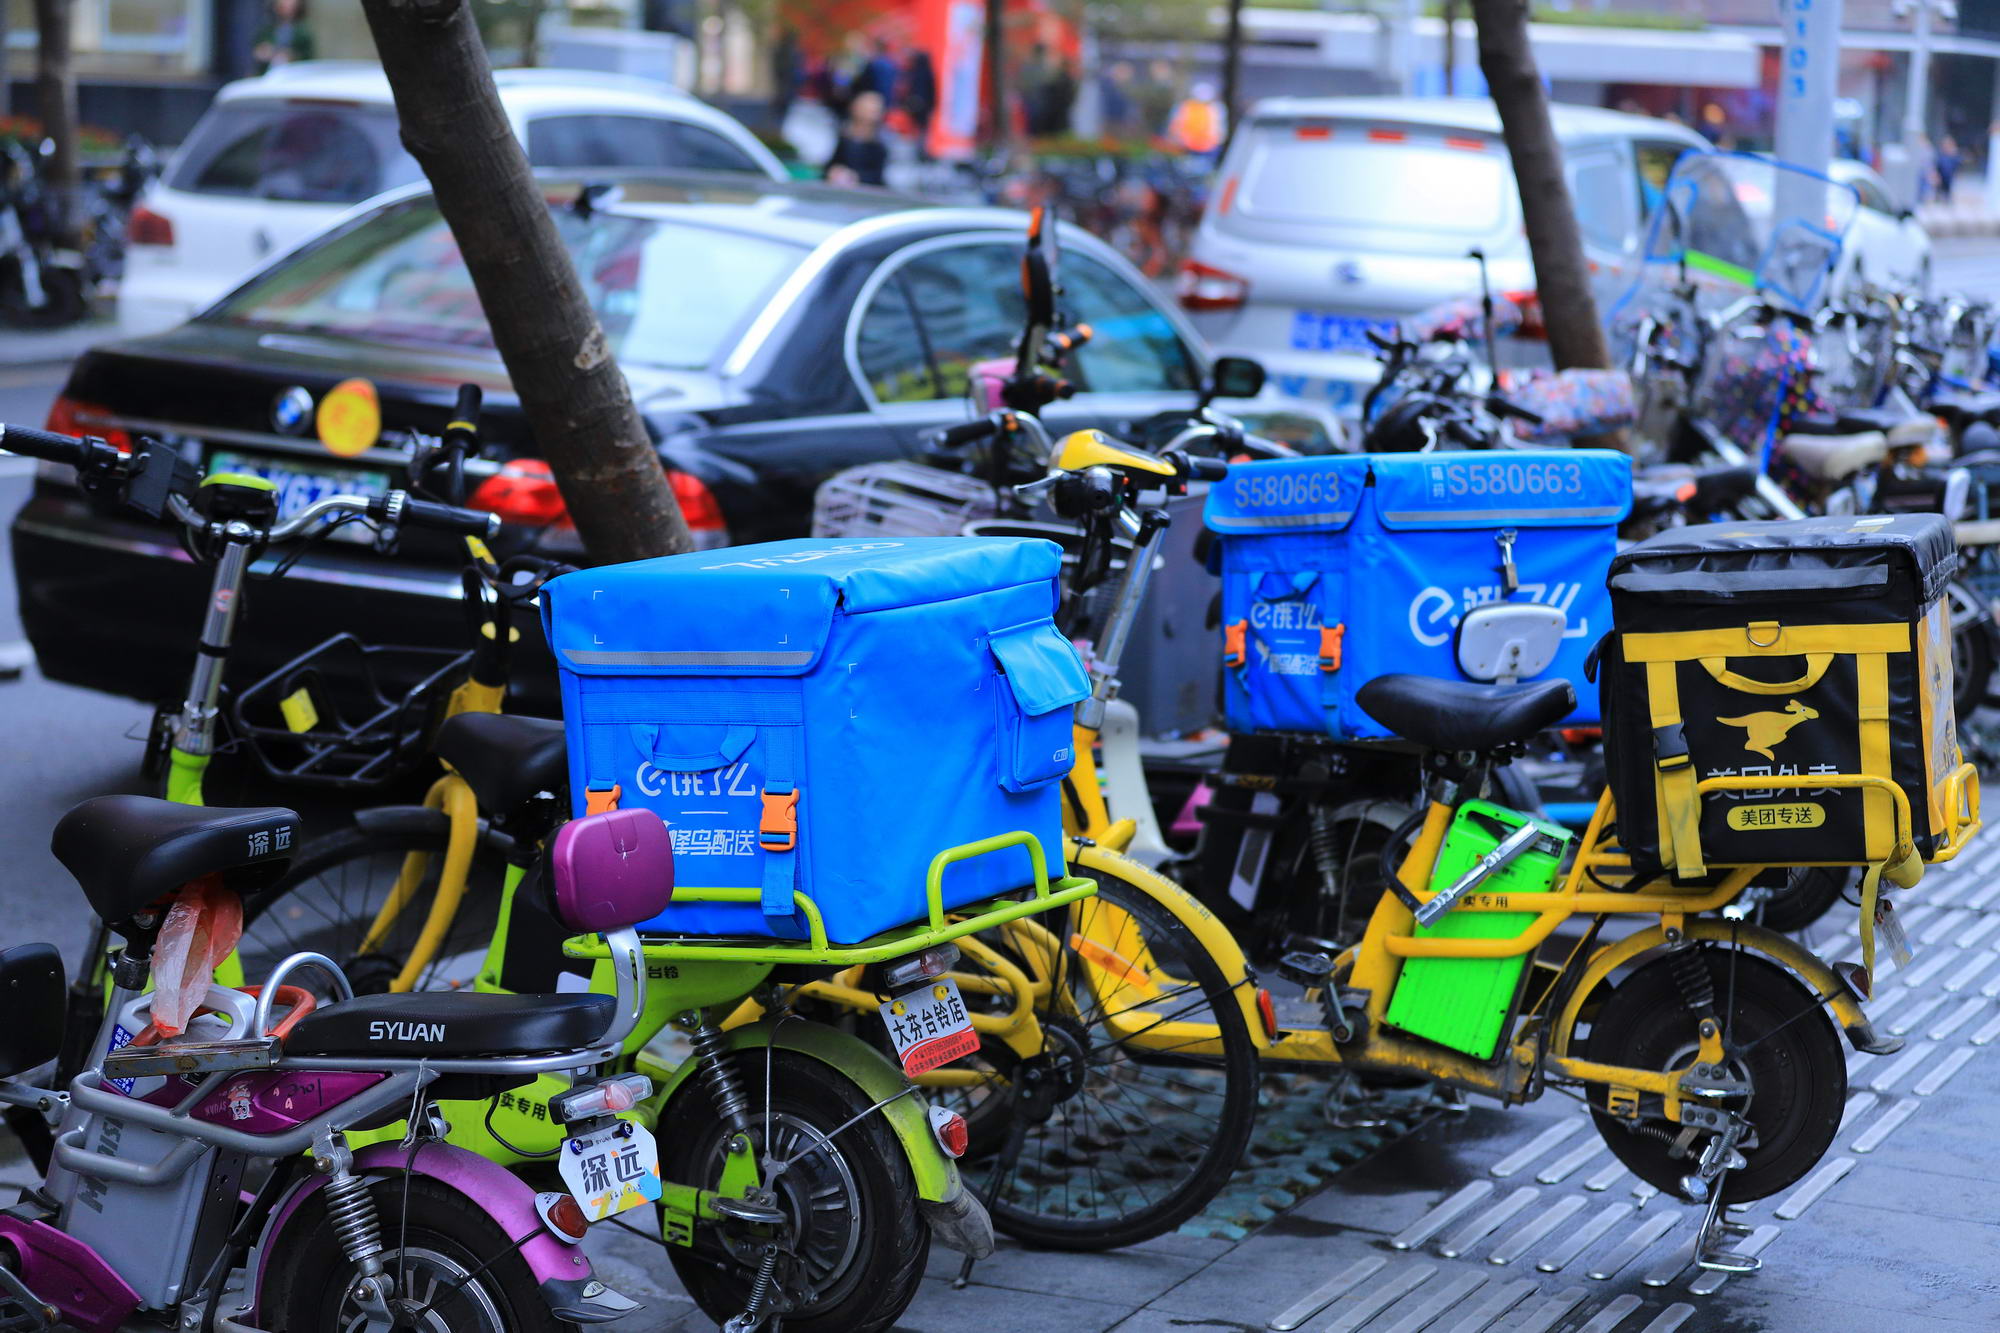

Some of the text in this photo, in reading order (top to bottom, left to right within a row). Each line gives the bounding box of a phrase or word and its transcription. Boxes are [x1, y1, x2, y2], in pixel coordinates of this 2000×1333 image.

[1234, 471, 1340, 508] S580663
[1448, 463, 1582, 495] S580663
[1741, 807, 1813, 827] 美团专送
[648, 966, 679, 979] 台铃
[369, 1021, 446, 1042] SYUAN
[892, 995, 965, 1047] 大芬台铃店
[486, 1092, 547, 1121] 卖专用
[581, 1143, 646, 1195] 深远
